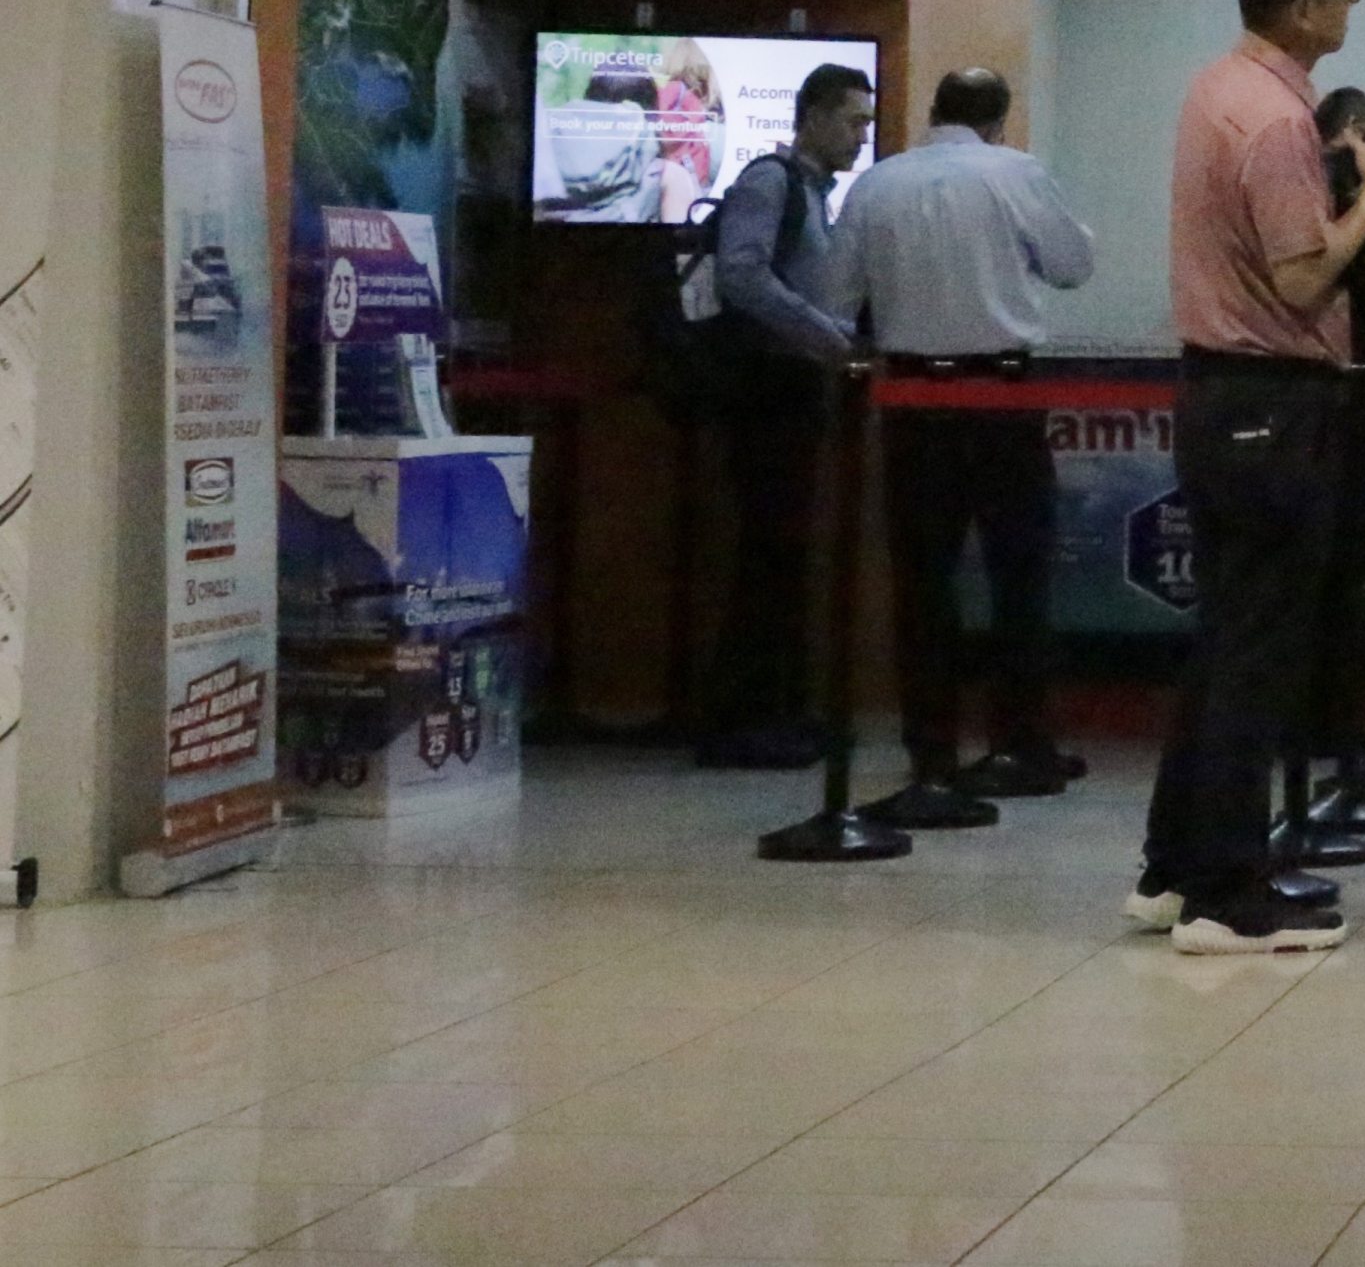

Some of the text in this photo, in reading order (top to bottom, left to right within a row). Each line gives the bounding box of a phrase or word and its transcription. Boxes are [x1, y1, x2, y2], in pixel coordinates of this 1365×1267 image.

[570, 45, 665, 71] Tripcetera
[585, 120, 614, 135] your
[616, 118, 647, 132] next
[328, 216, 393, 252] HOT DEALS
